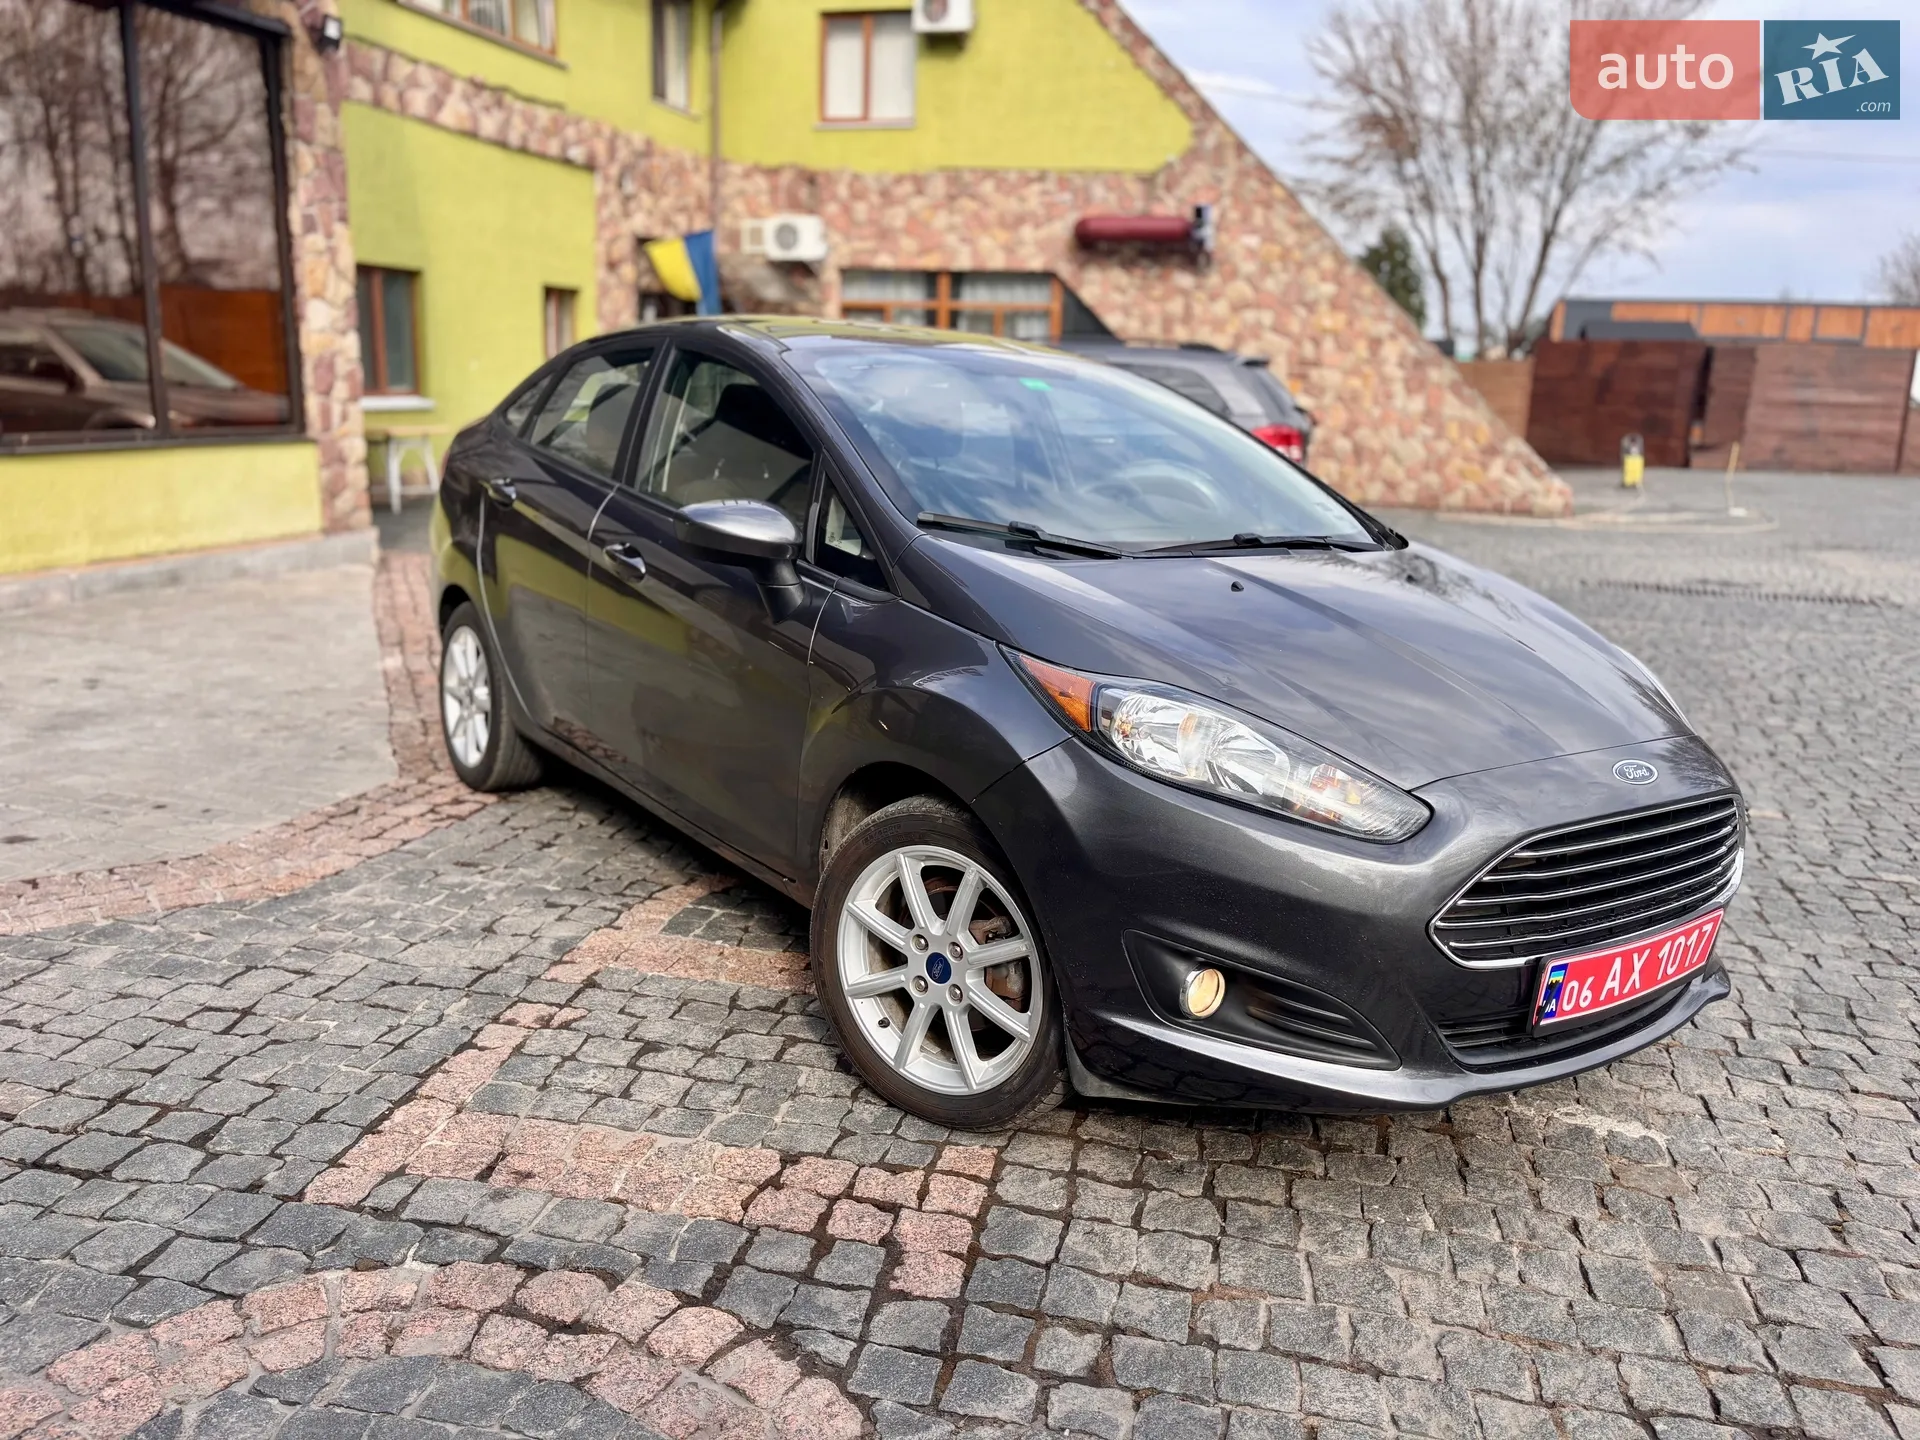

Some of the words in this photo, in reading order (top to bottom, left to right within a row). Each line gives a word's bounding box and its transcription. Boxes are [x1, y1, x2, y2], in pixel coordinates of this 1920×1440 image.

[1623, 764, 1650, 779] Ford
[1562, 976, 1595, 1011] 06
[1600, 948, 1651, 1001] AX
[1656, 922, 1714, 980] 1017
